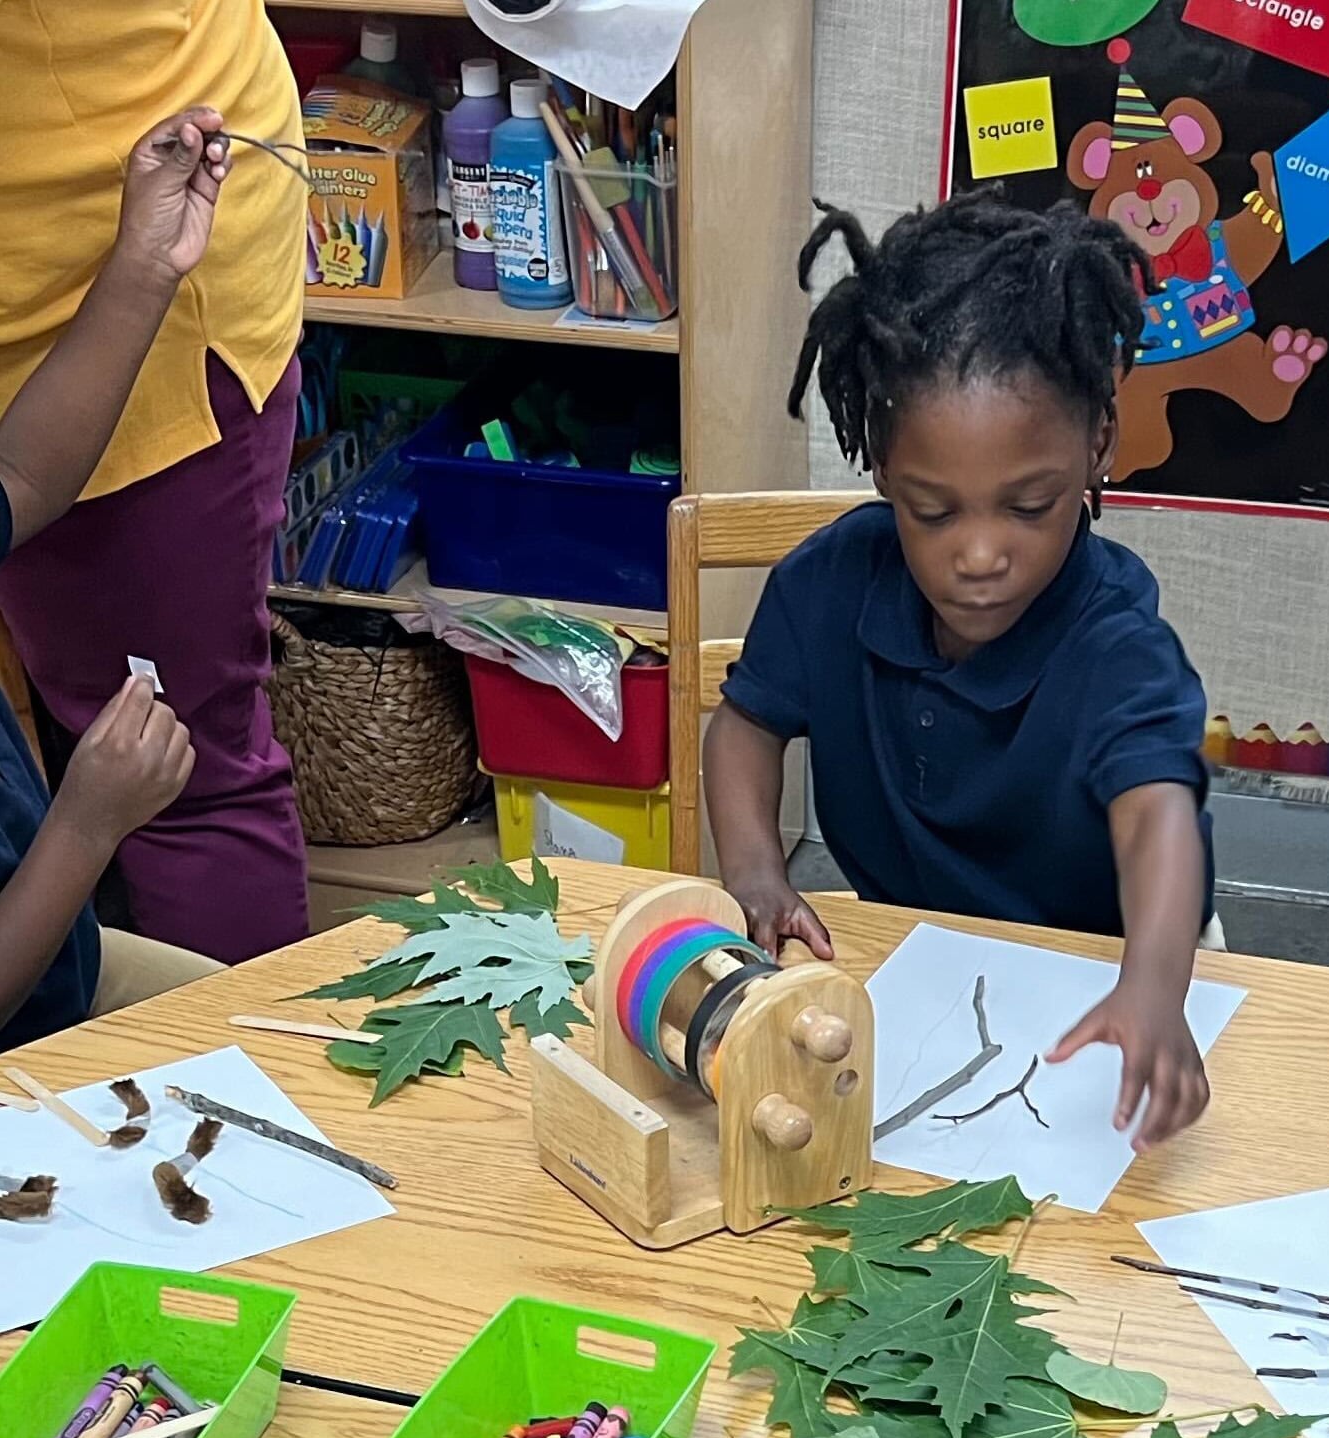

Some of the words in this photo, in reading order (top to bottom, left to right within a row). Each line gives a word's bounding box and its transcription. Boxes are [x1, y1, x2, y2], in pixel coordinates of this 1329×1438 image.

[1234, 0, 1324, 30] ctangle
[978, 118, 1045, 140] square
[342, 168, 377, 186] Glue
[333, 243, 351, 266] 12
